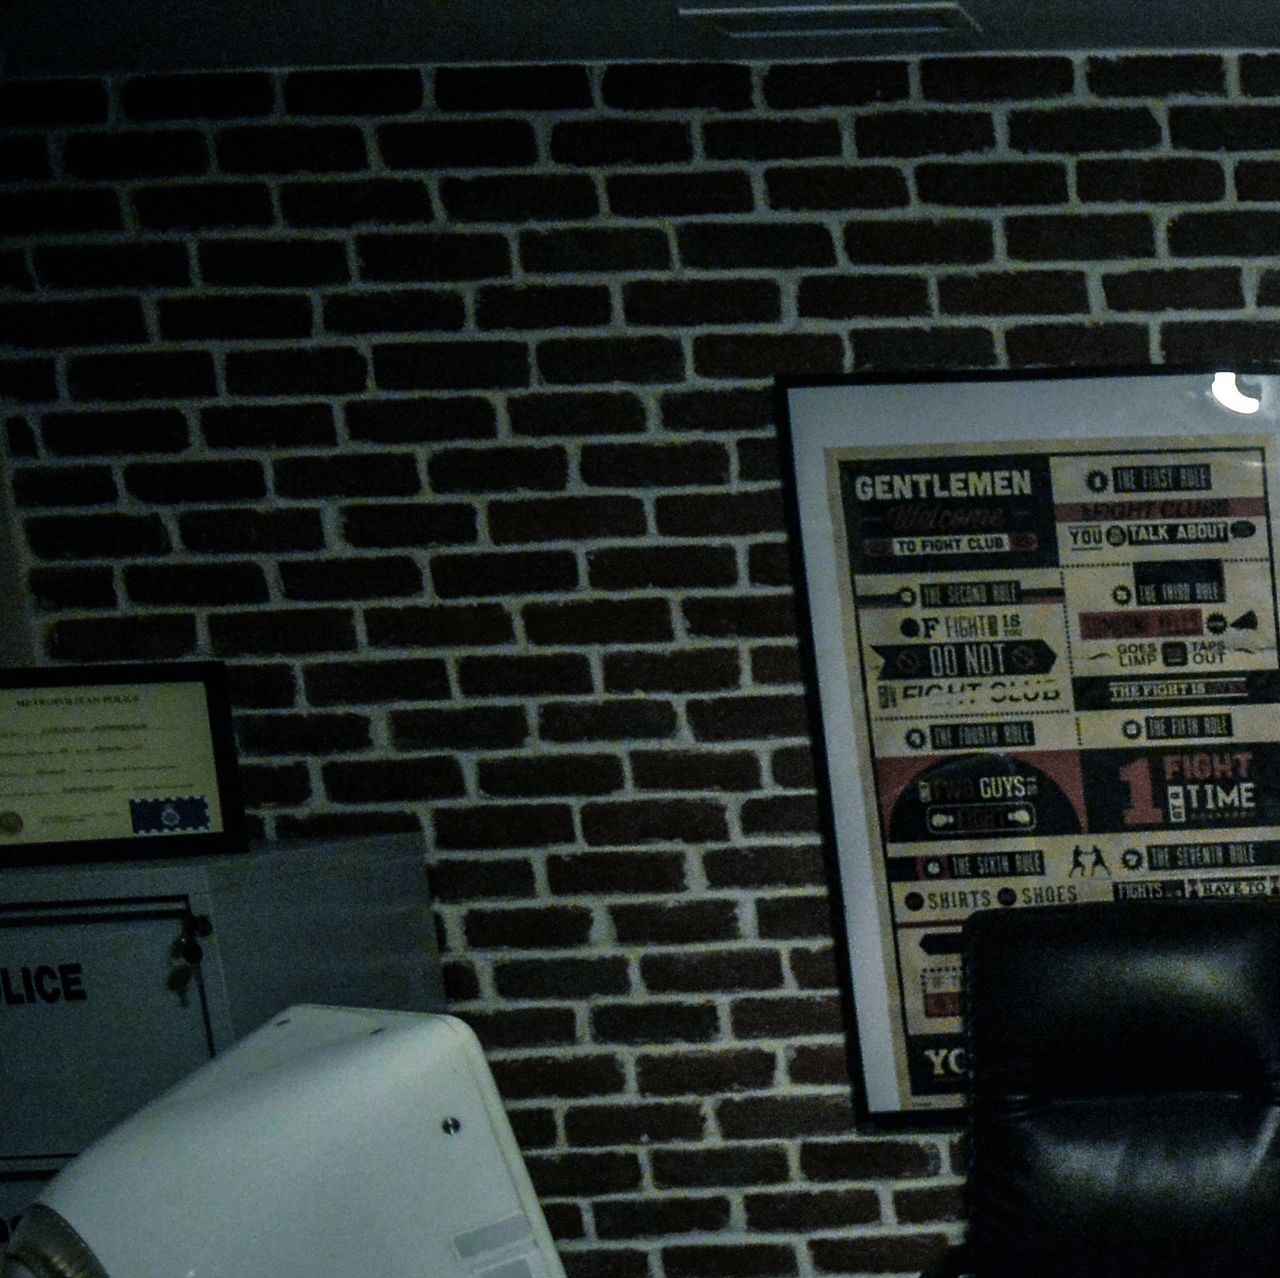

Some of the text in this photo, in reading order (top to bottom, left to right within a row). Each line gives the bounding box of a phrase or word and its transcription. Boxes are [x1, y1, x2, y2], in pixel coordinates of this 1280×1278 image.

[855, 469, 1033, 501] GENTLEMEN
[1070, 527, 1102, 546] YOU
[1129, 524, 1169, 542] TALK
[1176, 522, 1226, 540] ABOUT
[898, 536, 1004, 554] TO FIGHT CLUB
[1117, 643, 1158, 655] GOES
[1193, 641, 1227, 653] TAPS
[929, 643, 1006, 677] DO NOT
[1119, 654, 1158, 667] LIMP
[1193, 652, 1226, 665] OUT
[1111, 684, 1140, 699] THE
[1143, 682, 1188, 697] FIGHT
[1163, 751, 1253, 780] FIGHT
[979, 776, 1026, 799] GUYS
[1119, 757, 1164, 824] 1
[1186, 782, 1256, 810] TIME
[1022, 885, 1078, 905] SHOES
[1118, 883, 1163, 899] FIGHTS
[1203, 881, 1266, 895] HAVE TO
[928, 890, 992, 910] SHIRTS
[0, 962, 87, 1006] LICE
[924, 1047, 966, 1076] YO
